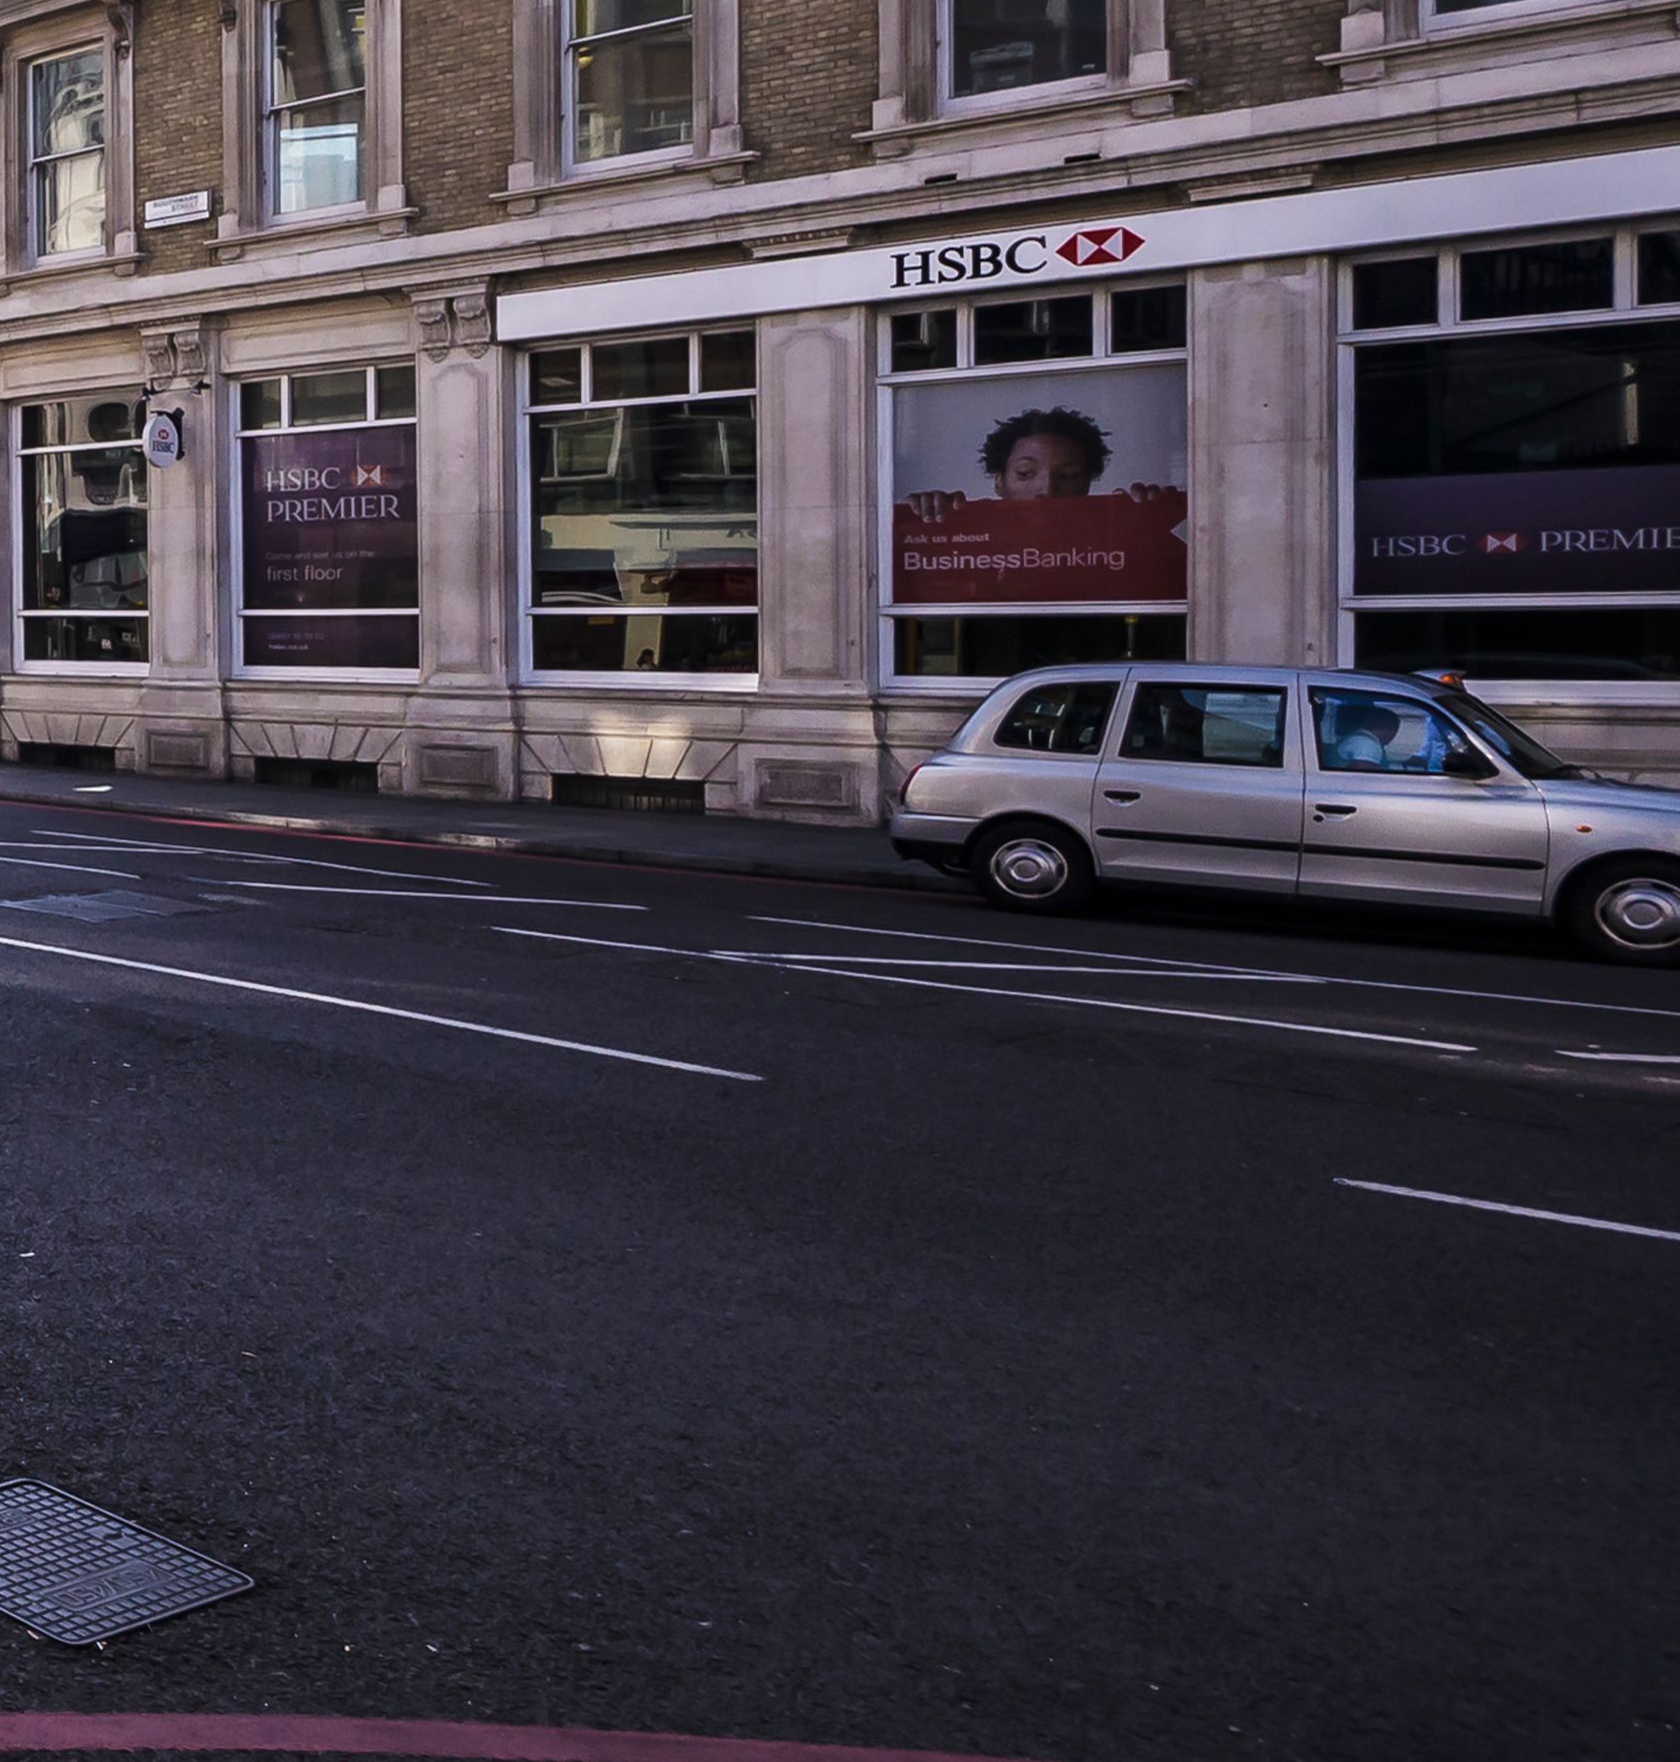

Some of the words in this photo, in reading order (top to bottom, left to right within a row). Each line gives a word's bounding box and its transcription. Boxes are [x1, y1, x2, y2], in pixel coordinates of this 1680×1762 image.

[890, 235, 1048, 289] HSBC
[152, 440, 175, 454] HSBC
[266, 467, 341, 493] HSBC
[266, 494, 401, 523] PREMIER
[904, 535, 928, 544] Ask
[932, 535, 948, 544] us
[952, 533, 990, 543] about
[1372, 534, 1467, 558] HSBC
[903, 545, 1126, 571] BusinessBanking
[266, 565, 300, 582] first
[304, 564, 344, 581] floor
